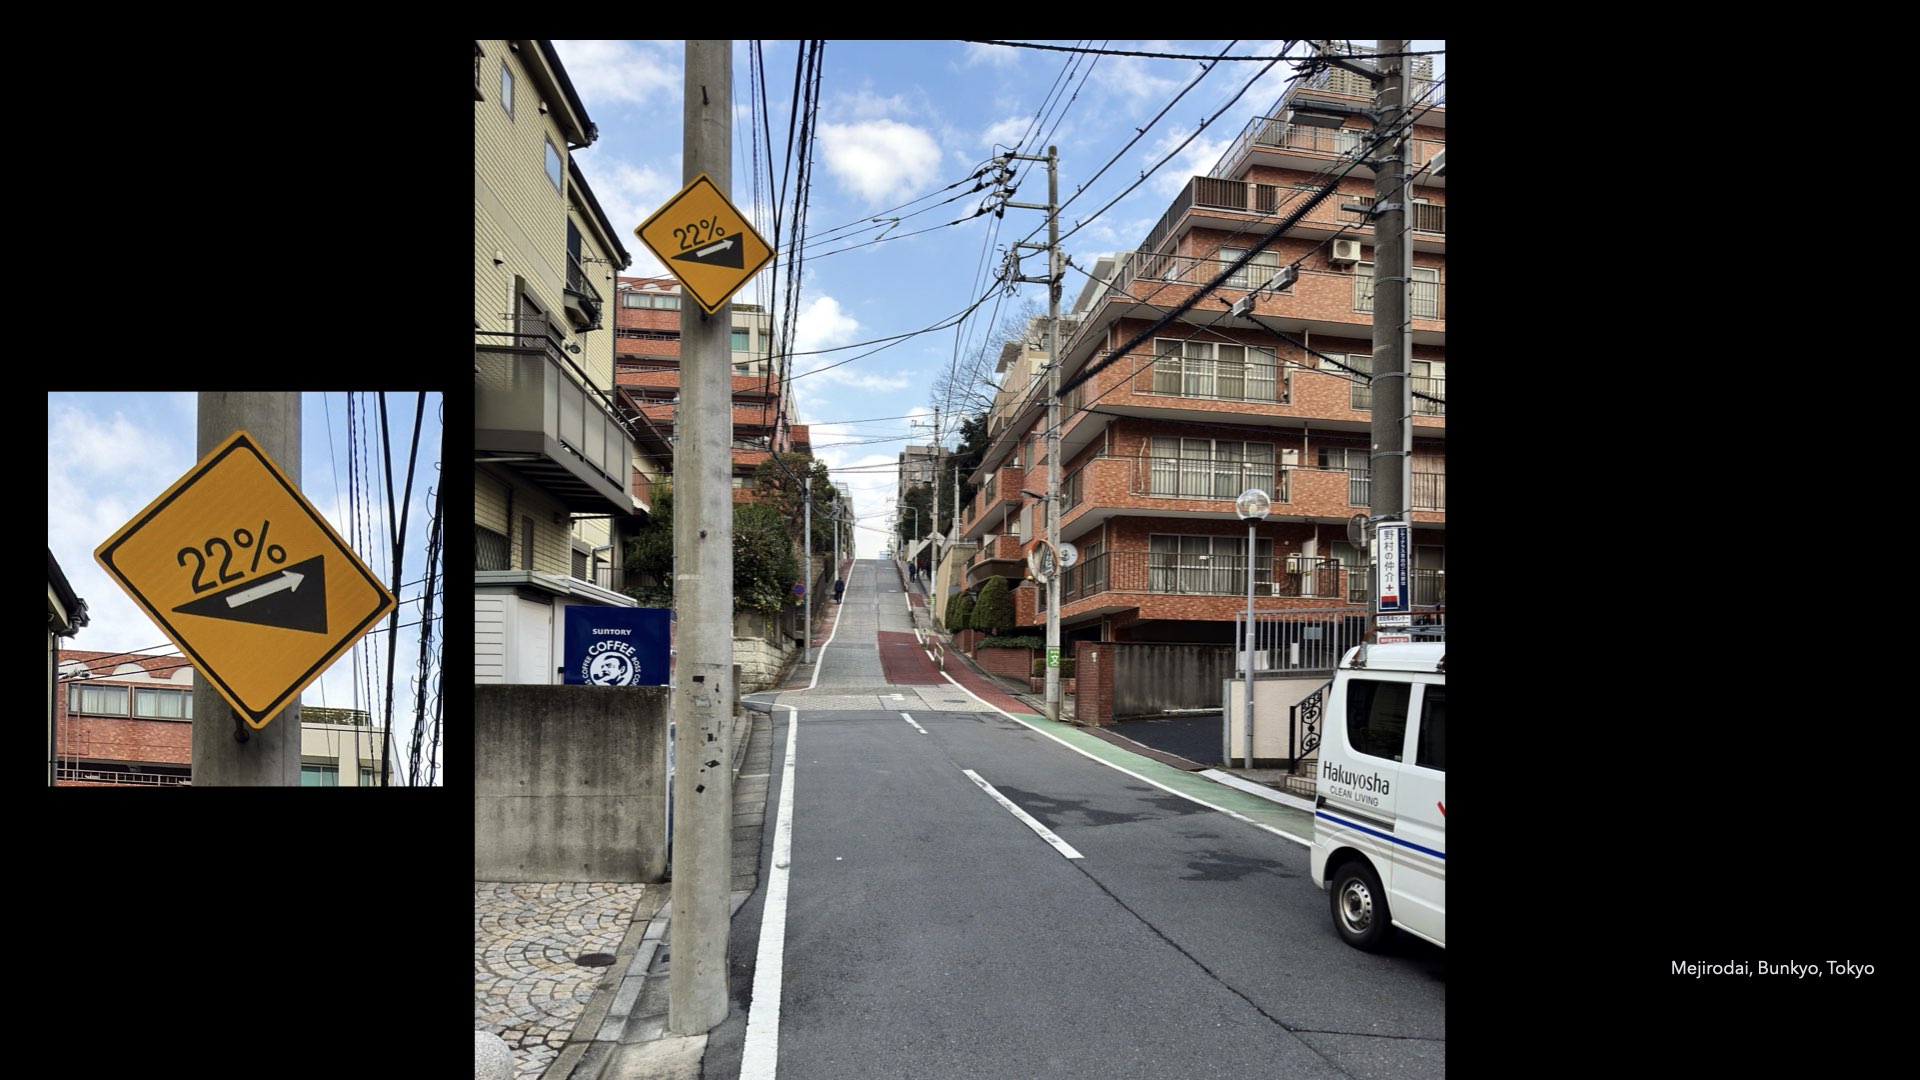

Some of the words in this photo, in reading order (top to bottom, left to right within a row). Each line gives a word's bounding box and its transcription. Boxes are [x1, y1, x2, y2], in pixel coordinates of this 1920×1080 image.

[673, 216, 725, 250] 22%
[177, 520, 287, 594] 22%
[588, 640, 636, 656] COFFEE
[631, 656, 641, 673] BOSS
[1323, 758, 1390, 795] Hakuyosha
[1329, 785, 1352, 798] CLEAN
[1354, 793, 1379, 807] LIVING
